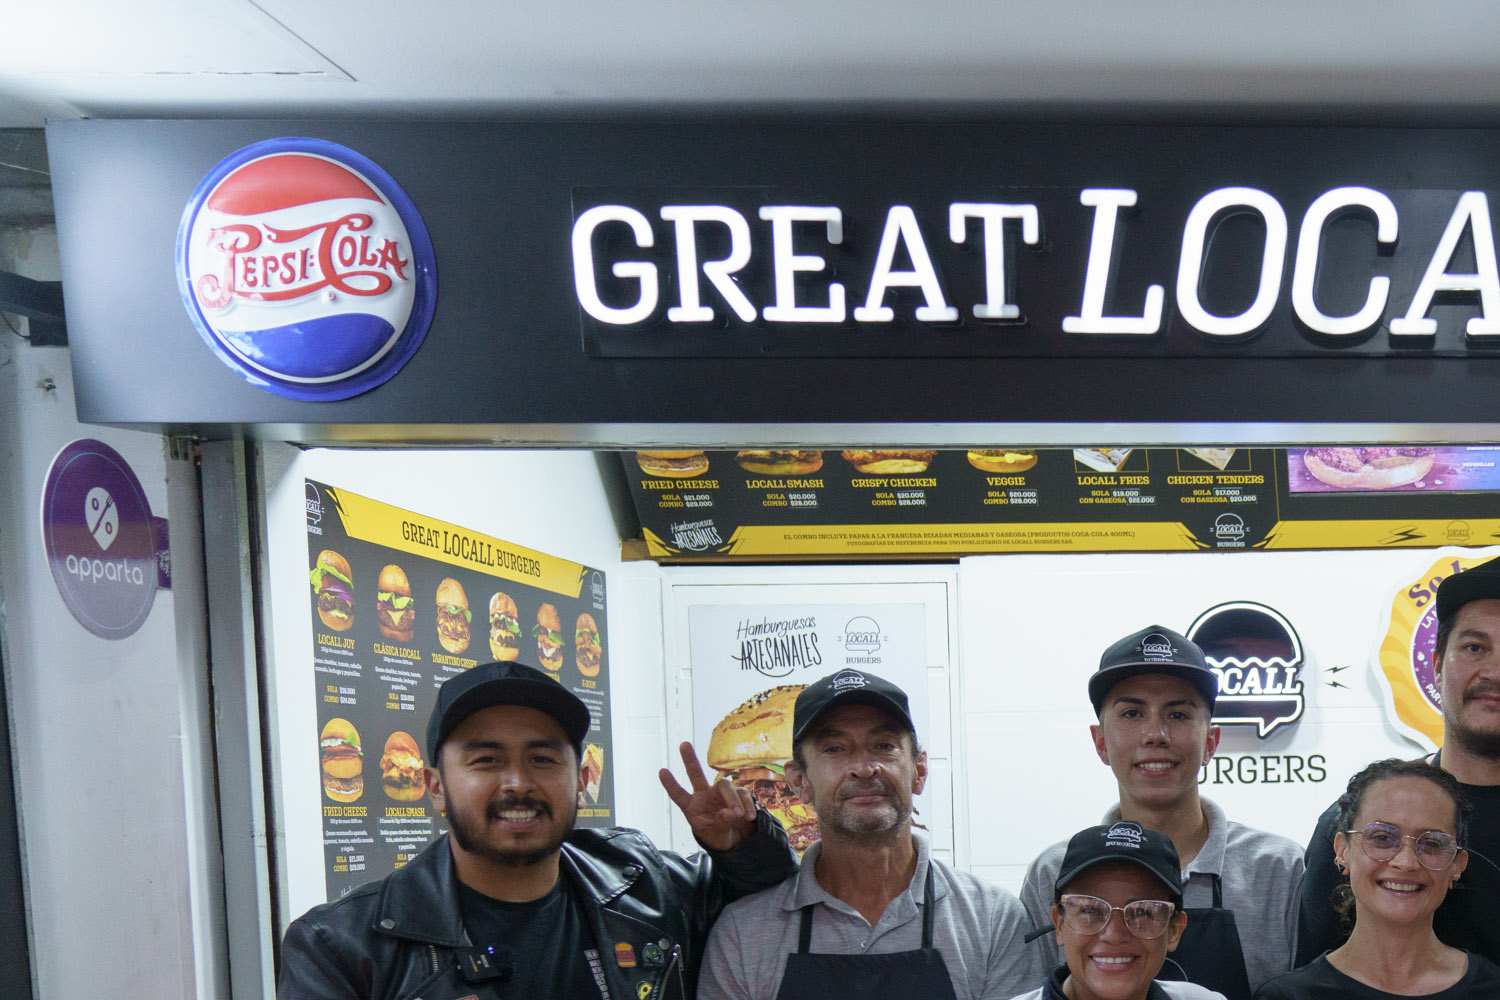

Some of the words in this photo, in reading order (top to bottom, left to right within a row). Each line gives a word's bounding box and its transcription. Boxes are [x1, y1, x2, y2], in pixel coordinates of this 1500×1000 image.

[571, 203, 1038, 325] GREAT
[641, 480, 675, 490] FRIED
[676, 479, 719, 490] CHEESE
[746, 480, 786, 489] LOCALL
[787, 479, 824, 489] SMASH
[851, 478, 889, 488] CRISPY
[890, 478, 937, 487] CHICKEN
[987, 477, 1025, 486] VEGGIE
[1077, 476, 1117, 486] LOCALL
[1119, 476, 1149, 485] FRIES
[1167, 476, 1213, 485] CHICKEN
[1216, 475, 1264, 485] TENDERS
[662, 494, 681, 502] SOLA
[1193, 489, 1212, 497] SOLA
[658, 501, 684, 509] COMBO
[762, 500, 788, 508] COMBO
[1079, 497, 1094, 505] CON
[1095, 497, 1127, 505] GASEOSA
[1196, 496, 1228, 504] GASEOSA
[402, 521, 440, 549] GREAT
[443, 531, 494, 567] LOCALL
[496, 549, 541, 577] BURGERS
[66, 554, 144, 585] apparta
[737, 616, 816, 641] Hamburguesas
[318, 633, 342, 648] LOCALL
[343, 638, 355, 650] JOY
[846, 634, 881, 644] LOCALL
[373, 643, 399, 657] CLÁSICA
[399, 648, 421, 660] LOCALL
[731, 633, 822, 677] ARTESANALES
[846, 656, 882, 665] BURGERS
[323, 806, 343, 817] FRIED
[343, 806, 368, 817] CHEESE
[385, 807, 407, 817] LOCALL
[407, 807, 425, 817] SMASH
